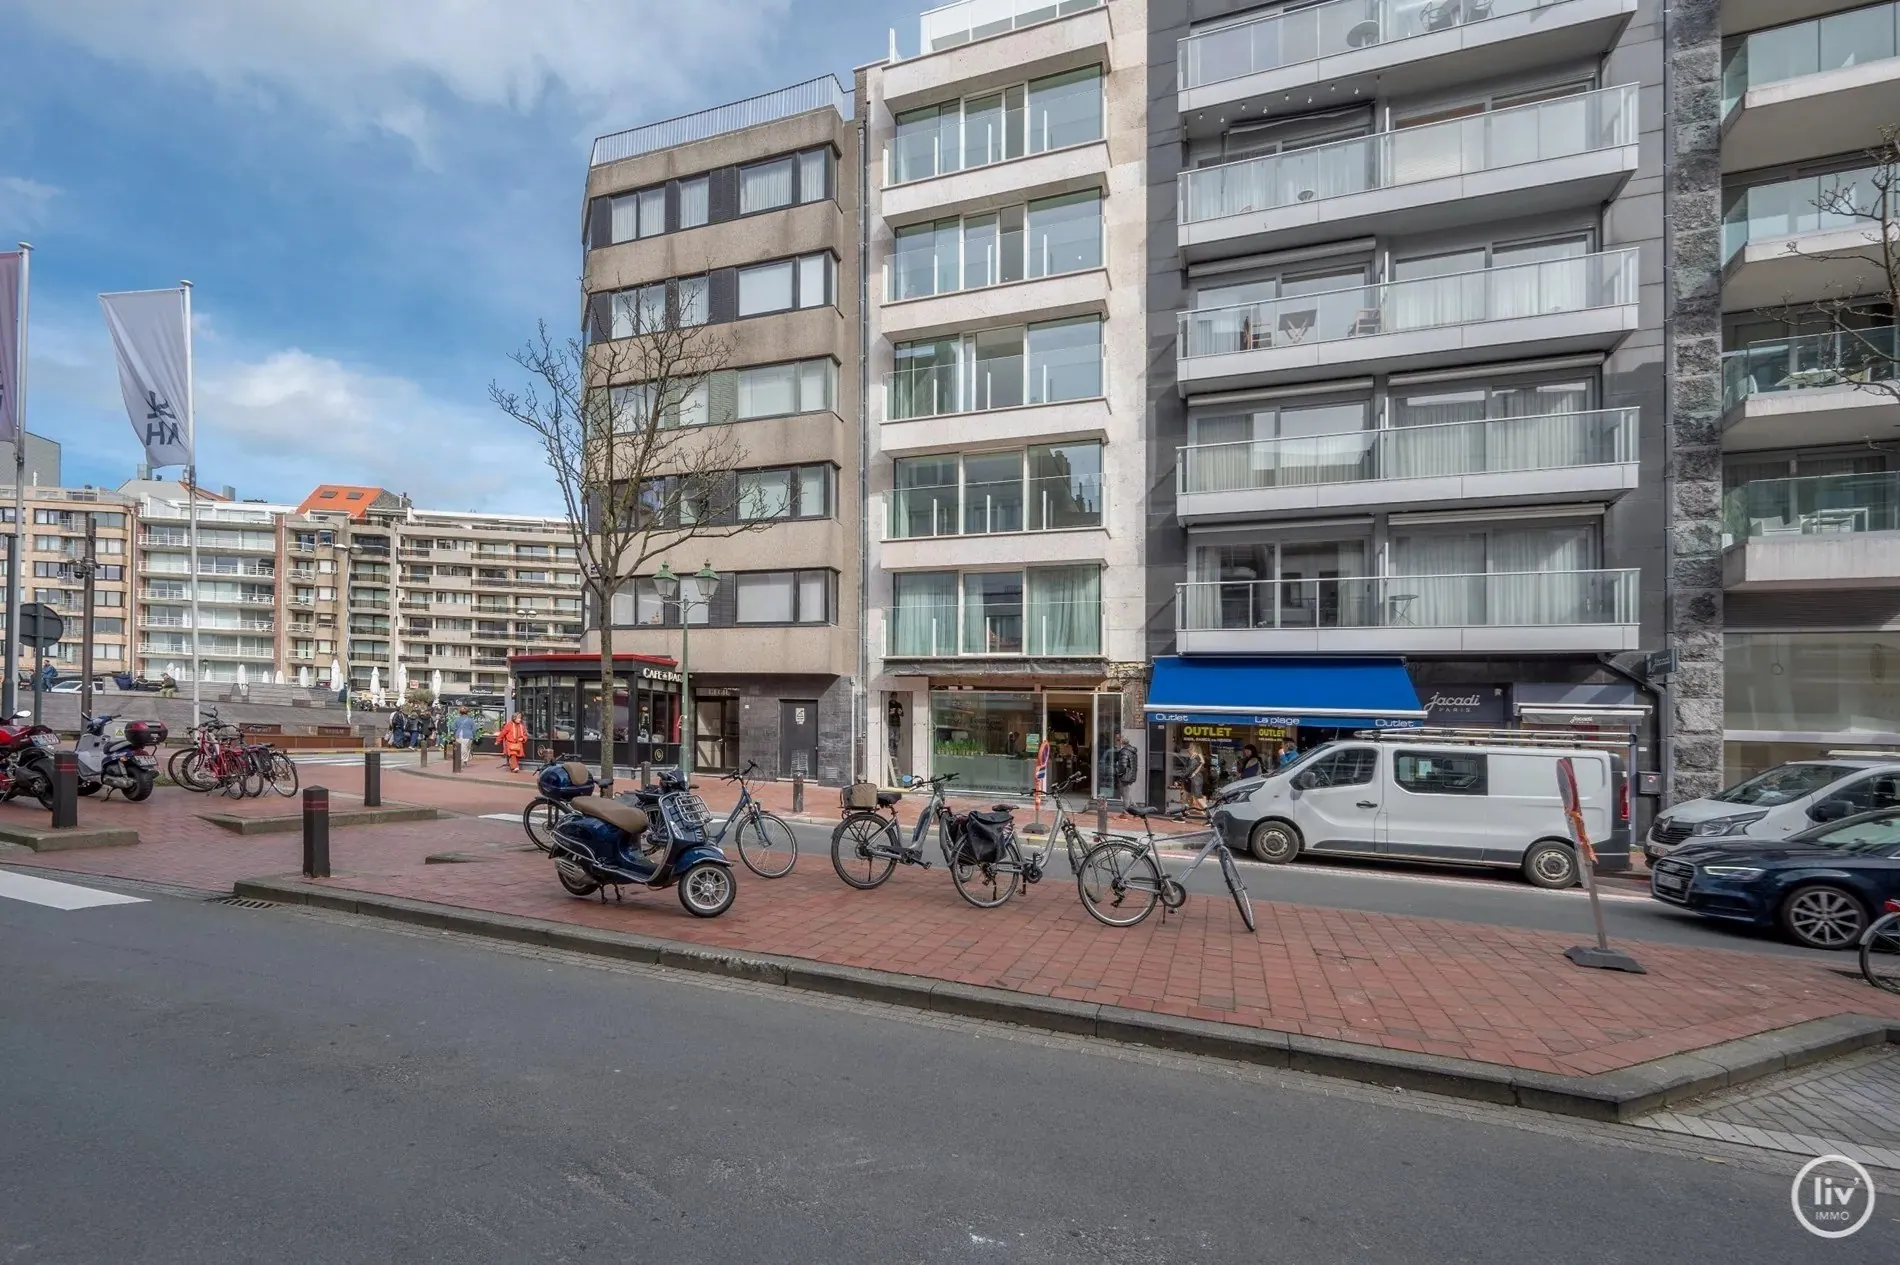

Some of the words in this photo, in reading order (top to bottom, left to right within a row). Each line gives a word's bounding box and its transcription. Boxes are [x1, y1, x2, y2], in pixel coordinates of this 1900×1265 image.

[643, 667, 662, 680] CAFE
[668, 671, 683, 683] PAR
[1423, 691, 1480, 712] jacadi
[1155, 713, 1189, 722] Outlet
[1254, 716, 1269, 724] La
[1270, 716, 1300, 726] plage
[1374, 718, 1415, 728] Outlet
[1183, 726, 1233, 737] OUTLET
[1258, 728, 1286, 738] OUTLET
